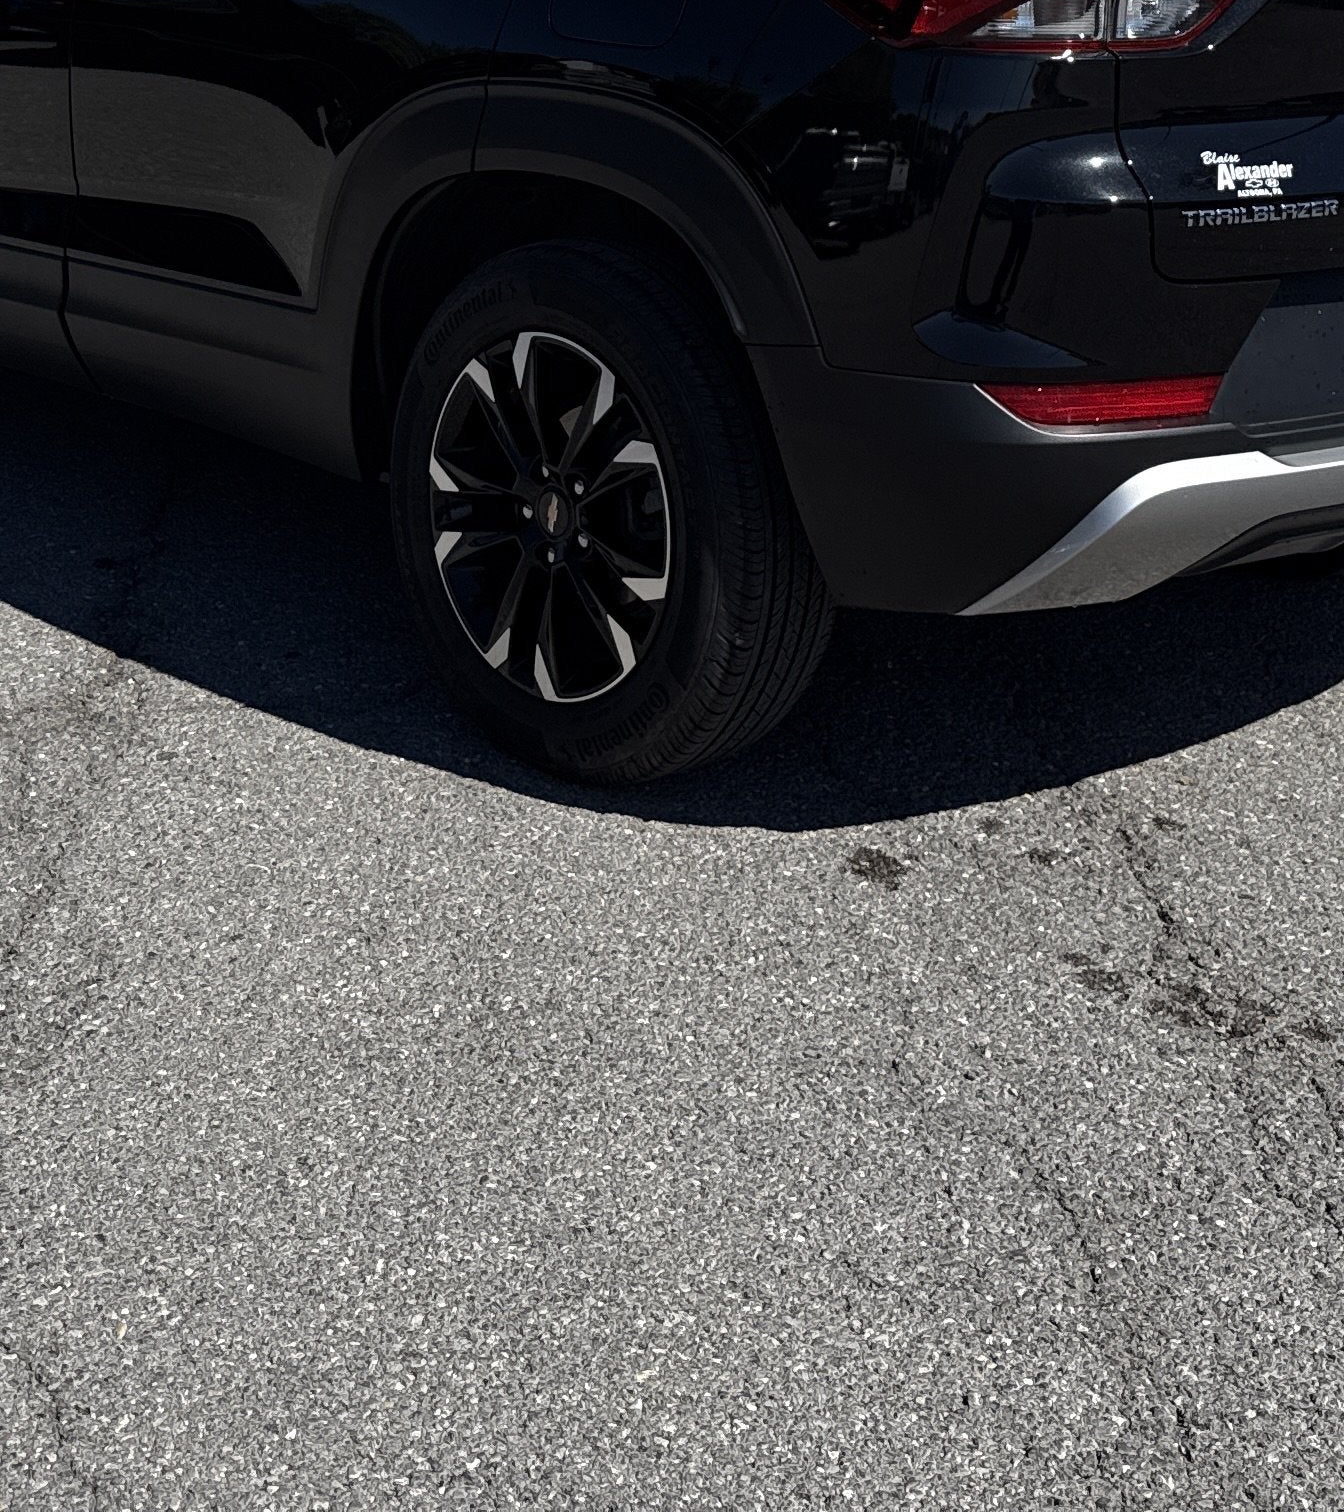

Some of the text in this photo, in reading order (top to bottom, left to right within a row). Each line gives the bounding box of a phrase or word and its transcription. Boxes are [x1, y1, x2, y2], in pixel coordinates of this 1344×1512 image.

[1200, 150, 1240, 165] Blaise
[1217, 161, 1294, 191] Alexander
[1182, 199, 1339, 227] TRAILBLAZER
